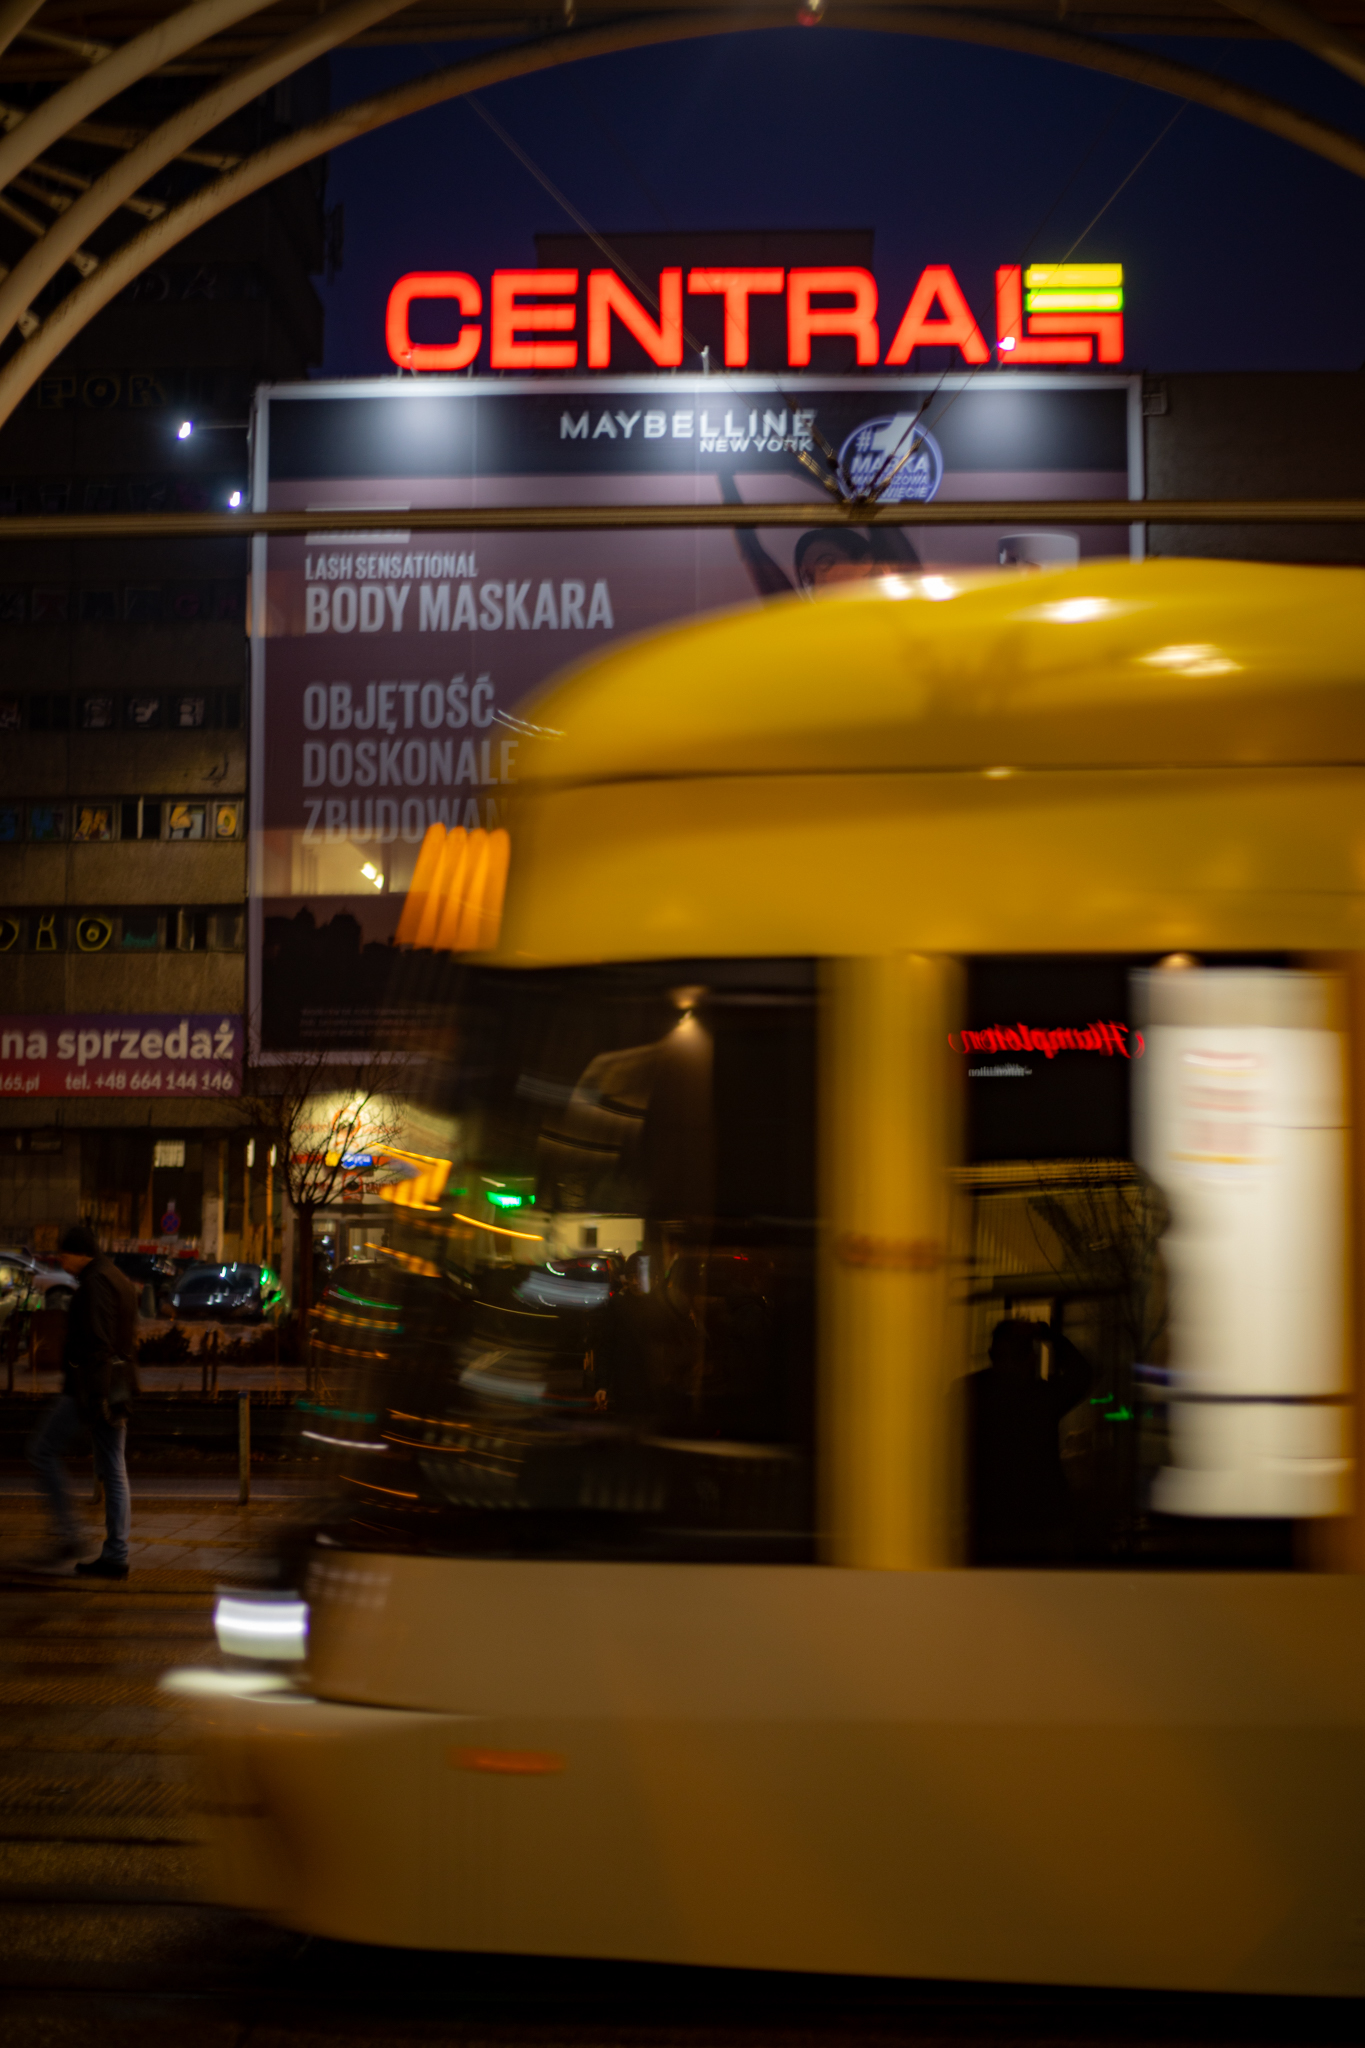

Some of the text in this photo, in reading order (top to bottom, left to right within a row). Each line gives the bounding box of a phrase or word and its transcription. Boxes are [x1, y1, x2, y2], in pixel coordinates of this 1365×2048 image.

[386, 264, 1123, 371] CENTRAL
[560, 409, 815, 439] MAYBELLINE
[700, 437, 813, 452] NEW YORK
[305, 552, 478, 580] LASH SENSATIONAL
[305, 580, 411, 634] BODY
[418, 578, 615, 631] MASKARA
[302, 673, 495, 735] OBJĘTOŚĆ
[302, 738, 519, 788] DOSKONALE
[1, 1018, 235, 1067] na sprzedaż
[64, 1068, 234, 1091] tel. +48 664 144 146
